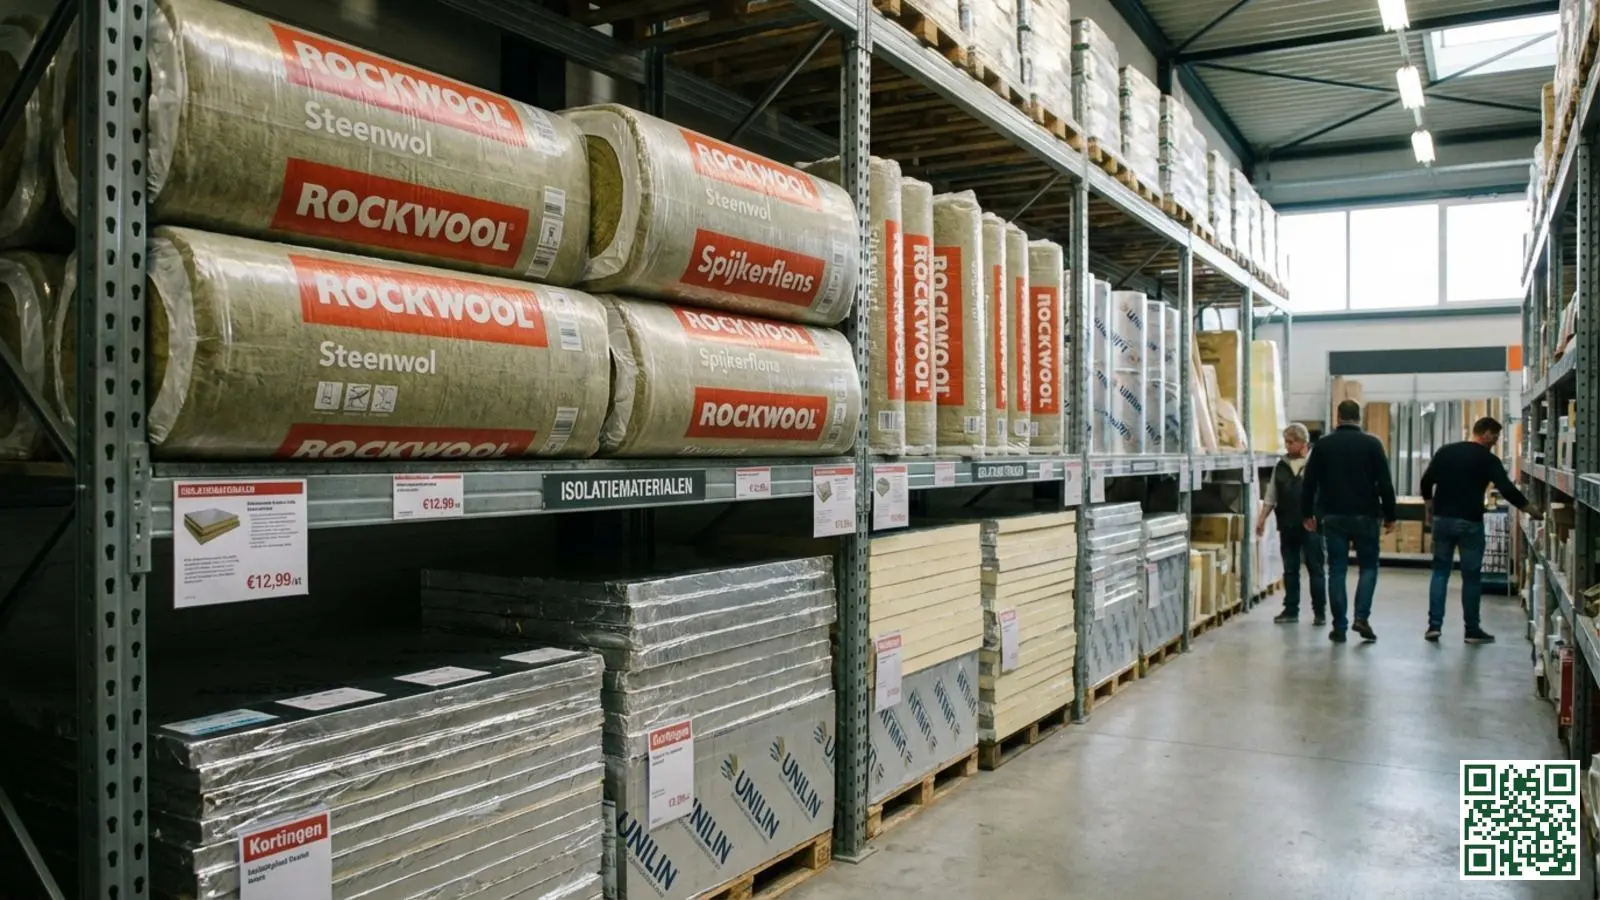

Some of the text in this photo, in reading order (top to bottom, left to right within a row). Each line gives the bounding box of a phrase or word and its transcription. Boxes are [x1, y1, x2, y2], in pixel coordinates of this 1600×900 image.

[293, 39, 513, 129] ROCKWOOL
[304, 100, 432, 158] Steenwol
[694, 141, 816, 200] ROCKWOOL
[295, 181, 514, 251] ROCKWOOL
[705, 188, 772, 221] Steenwol
[697, 244, 815, 294] Spijkerflens
[315, 273, 535, 329] ROCKWOOL
[685, 310, 809, 345] ROCKWOOL
[319, 340, 437, 375] Steenwol
[699, 401, 817, 430] ROCKWOOL
[290, 439, 510, 458] ROCKWOOL
[561, 477, 693, 501] ISOLATIEMATERIALEN
[735, 770, 780, 840] UNILIN
[782, 752, 822, 819] UNILIN
[249, 823, 322, 856] Kortingen
[616, 811, 679, 892] UNILIN
